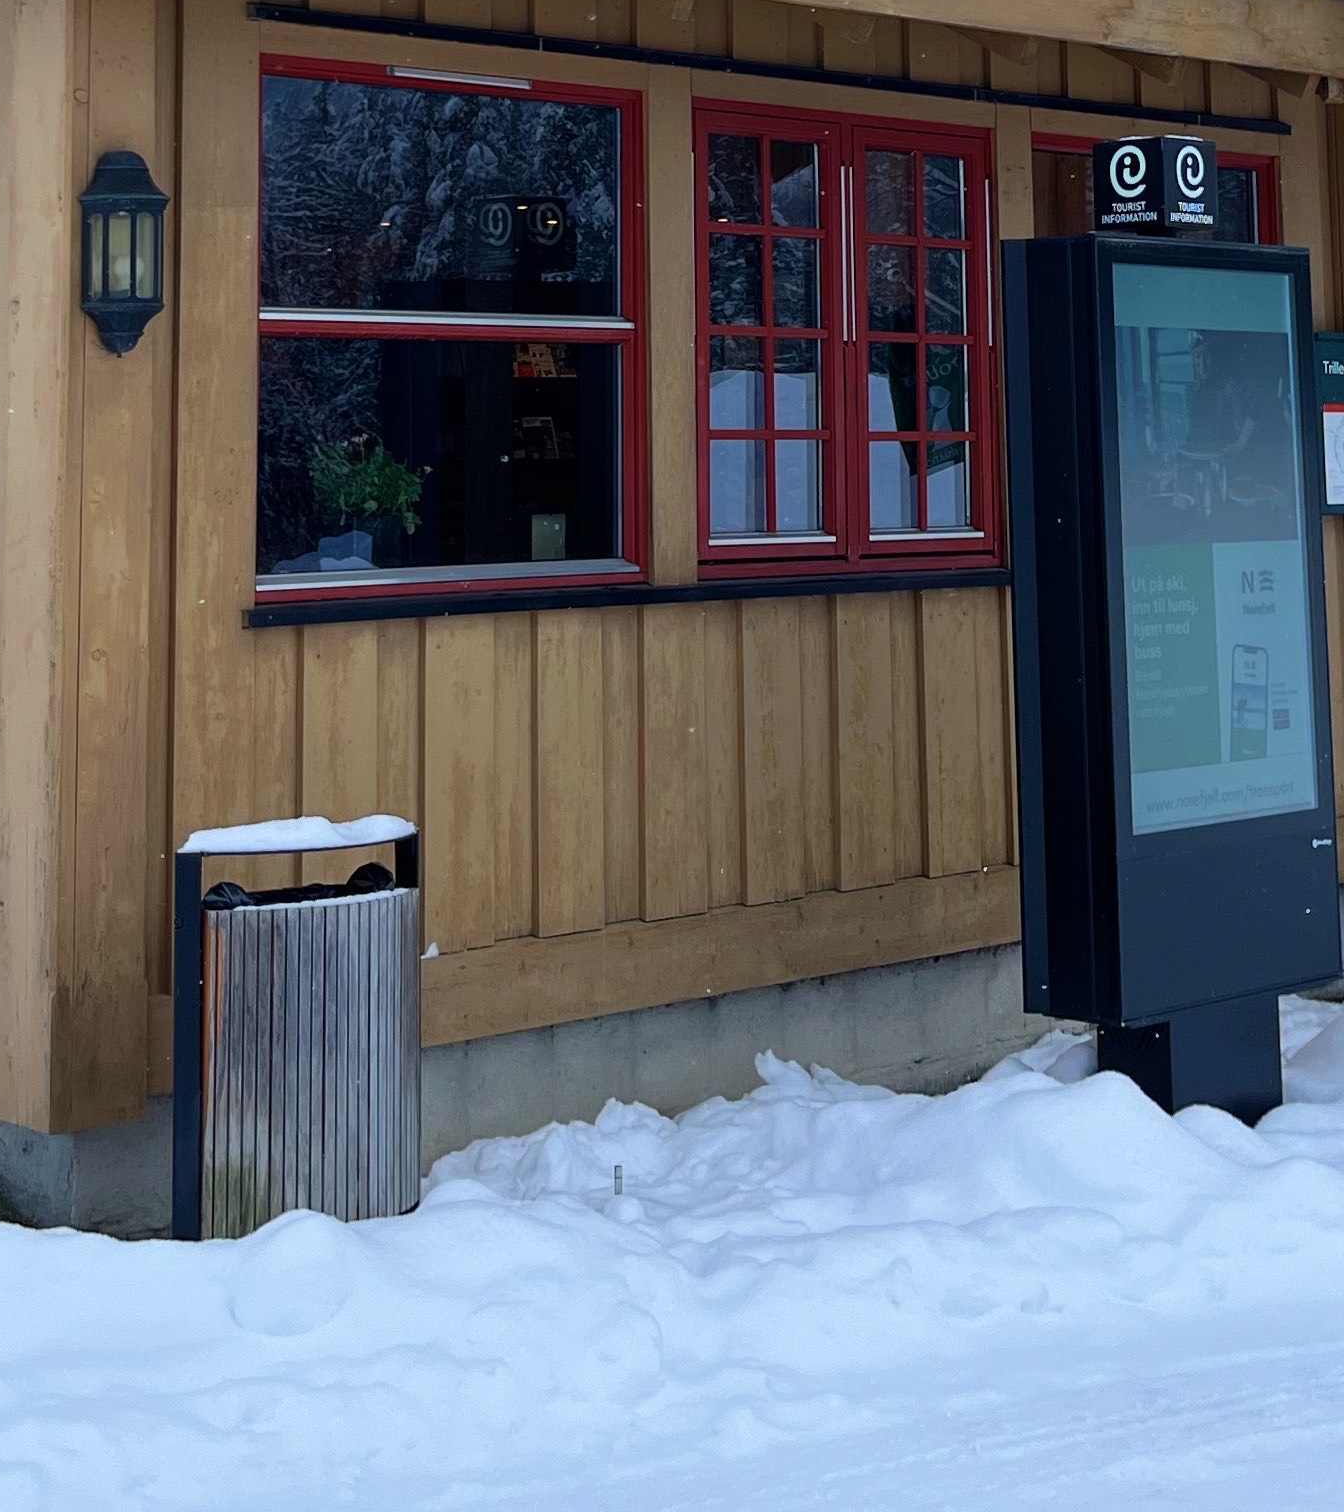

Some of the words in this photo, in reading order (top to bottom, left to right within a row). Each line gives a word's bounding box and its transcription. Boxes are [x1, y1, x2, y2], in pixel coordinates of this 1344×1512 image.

[1112, 201, 1146, 212] TOURIST
[1178, 201, 1205, 213] TOURIST
[1102, 212, 1157, 224] INFORMATION
[1170, 212, 1213, 224] INFORMATION
[1131, 576, 1146, 593] Ut
[1149, 574, 1163, 595] på
[1132, 600, 1150, 615] inn
[1154, 598, 1166, 613] til
[1133, 621, 1163, 641] hjem
[1165, 620, 1190, 634] med
[1134, 645, 1162, 660] buss
